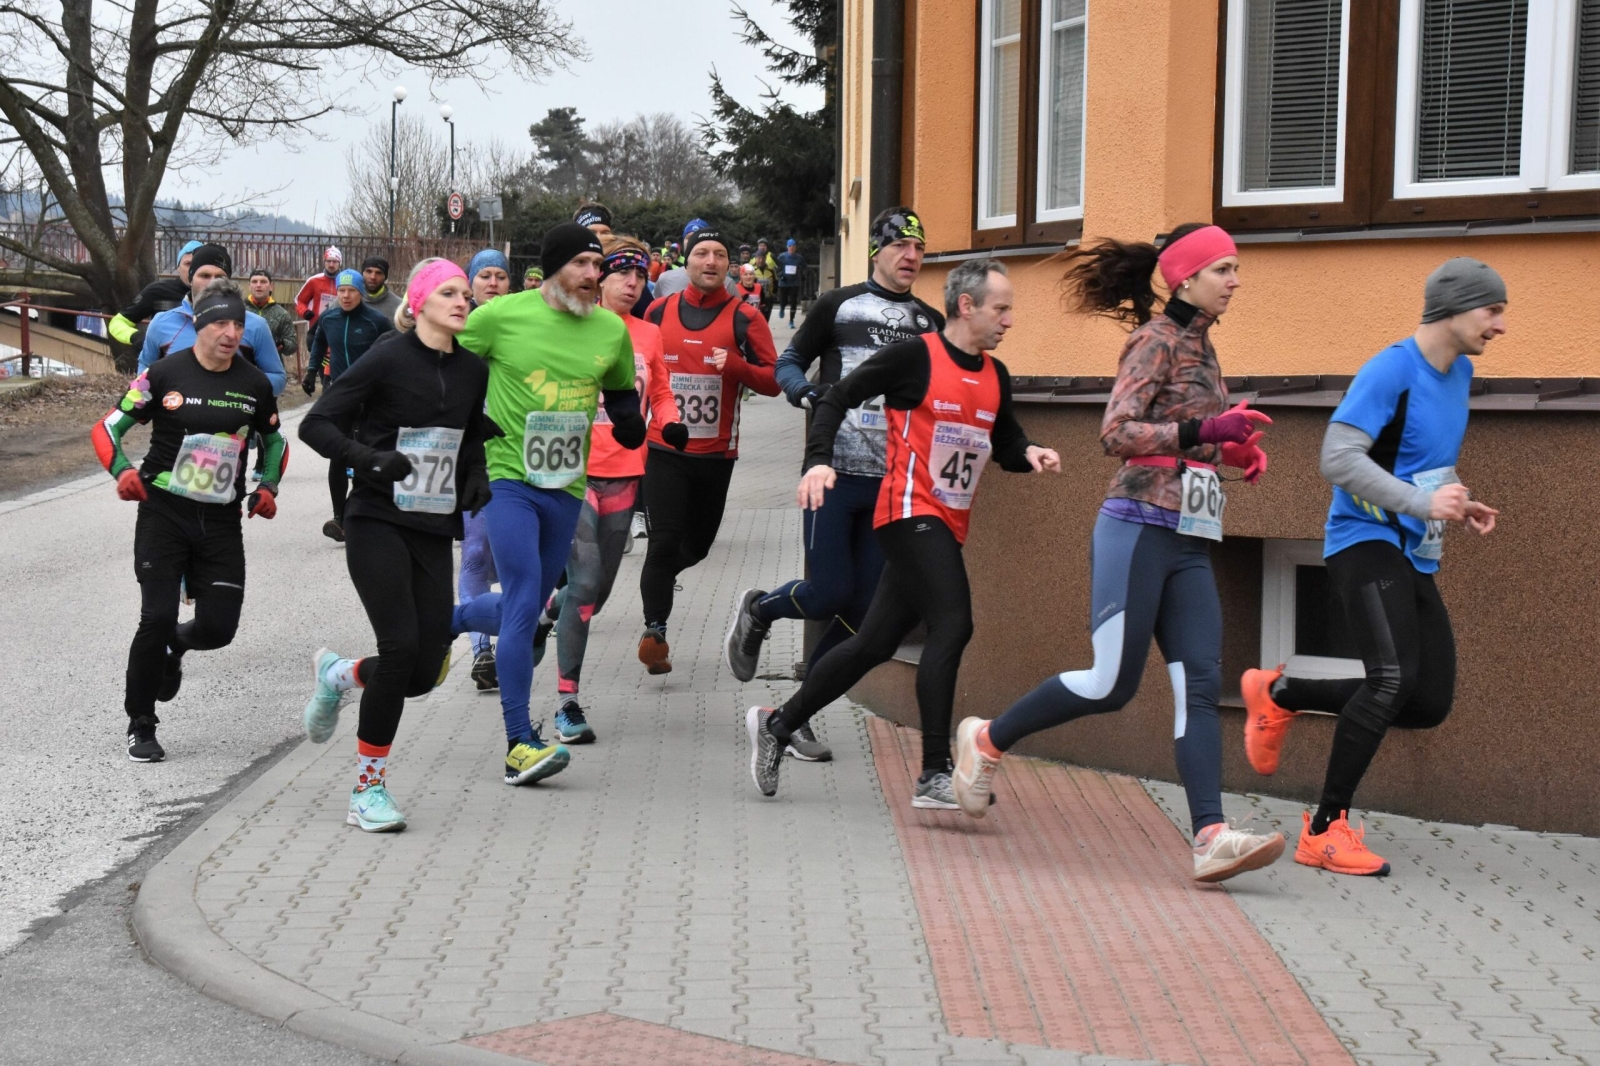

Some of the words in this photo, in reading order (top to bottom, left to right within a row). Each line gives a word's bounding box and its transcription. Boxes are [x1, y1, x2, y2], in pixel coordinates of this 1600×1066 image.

[672, 375, 693, 383] ZIMNÍ
[671, 382, 702, 391] BĚŽECKÁ
[185, 397, 202, 405] NN
[207, 399, 237, 409] NIGHT
[529, 414, 555, 423] ZIMNÍ
[527, 422, 565, 432] BĚŽECKÁ
[568, 424, 586, 432] LIGA
[937, 424, 963, 436] ZIMNÍ
[402, 430, 430, 438] ZIMNÍ
[399, 439, 440, 449] BĚŽECKÁ
[441, 442, 457, 450] LIGA
[934, 434, 970, 447] BĚŽECKÁ
[972, 440, 989, 450] LIGA
[221, 450, 237, 459] LIGA
[526, 435, 582, 472] 663
[175, 453, 233, 494] 659
[940, 450, 978, 490] 45
